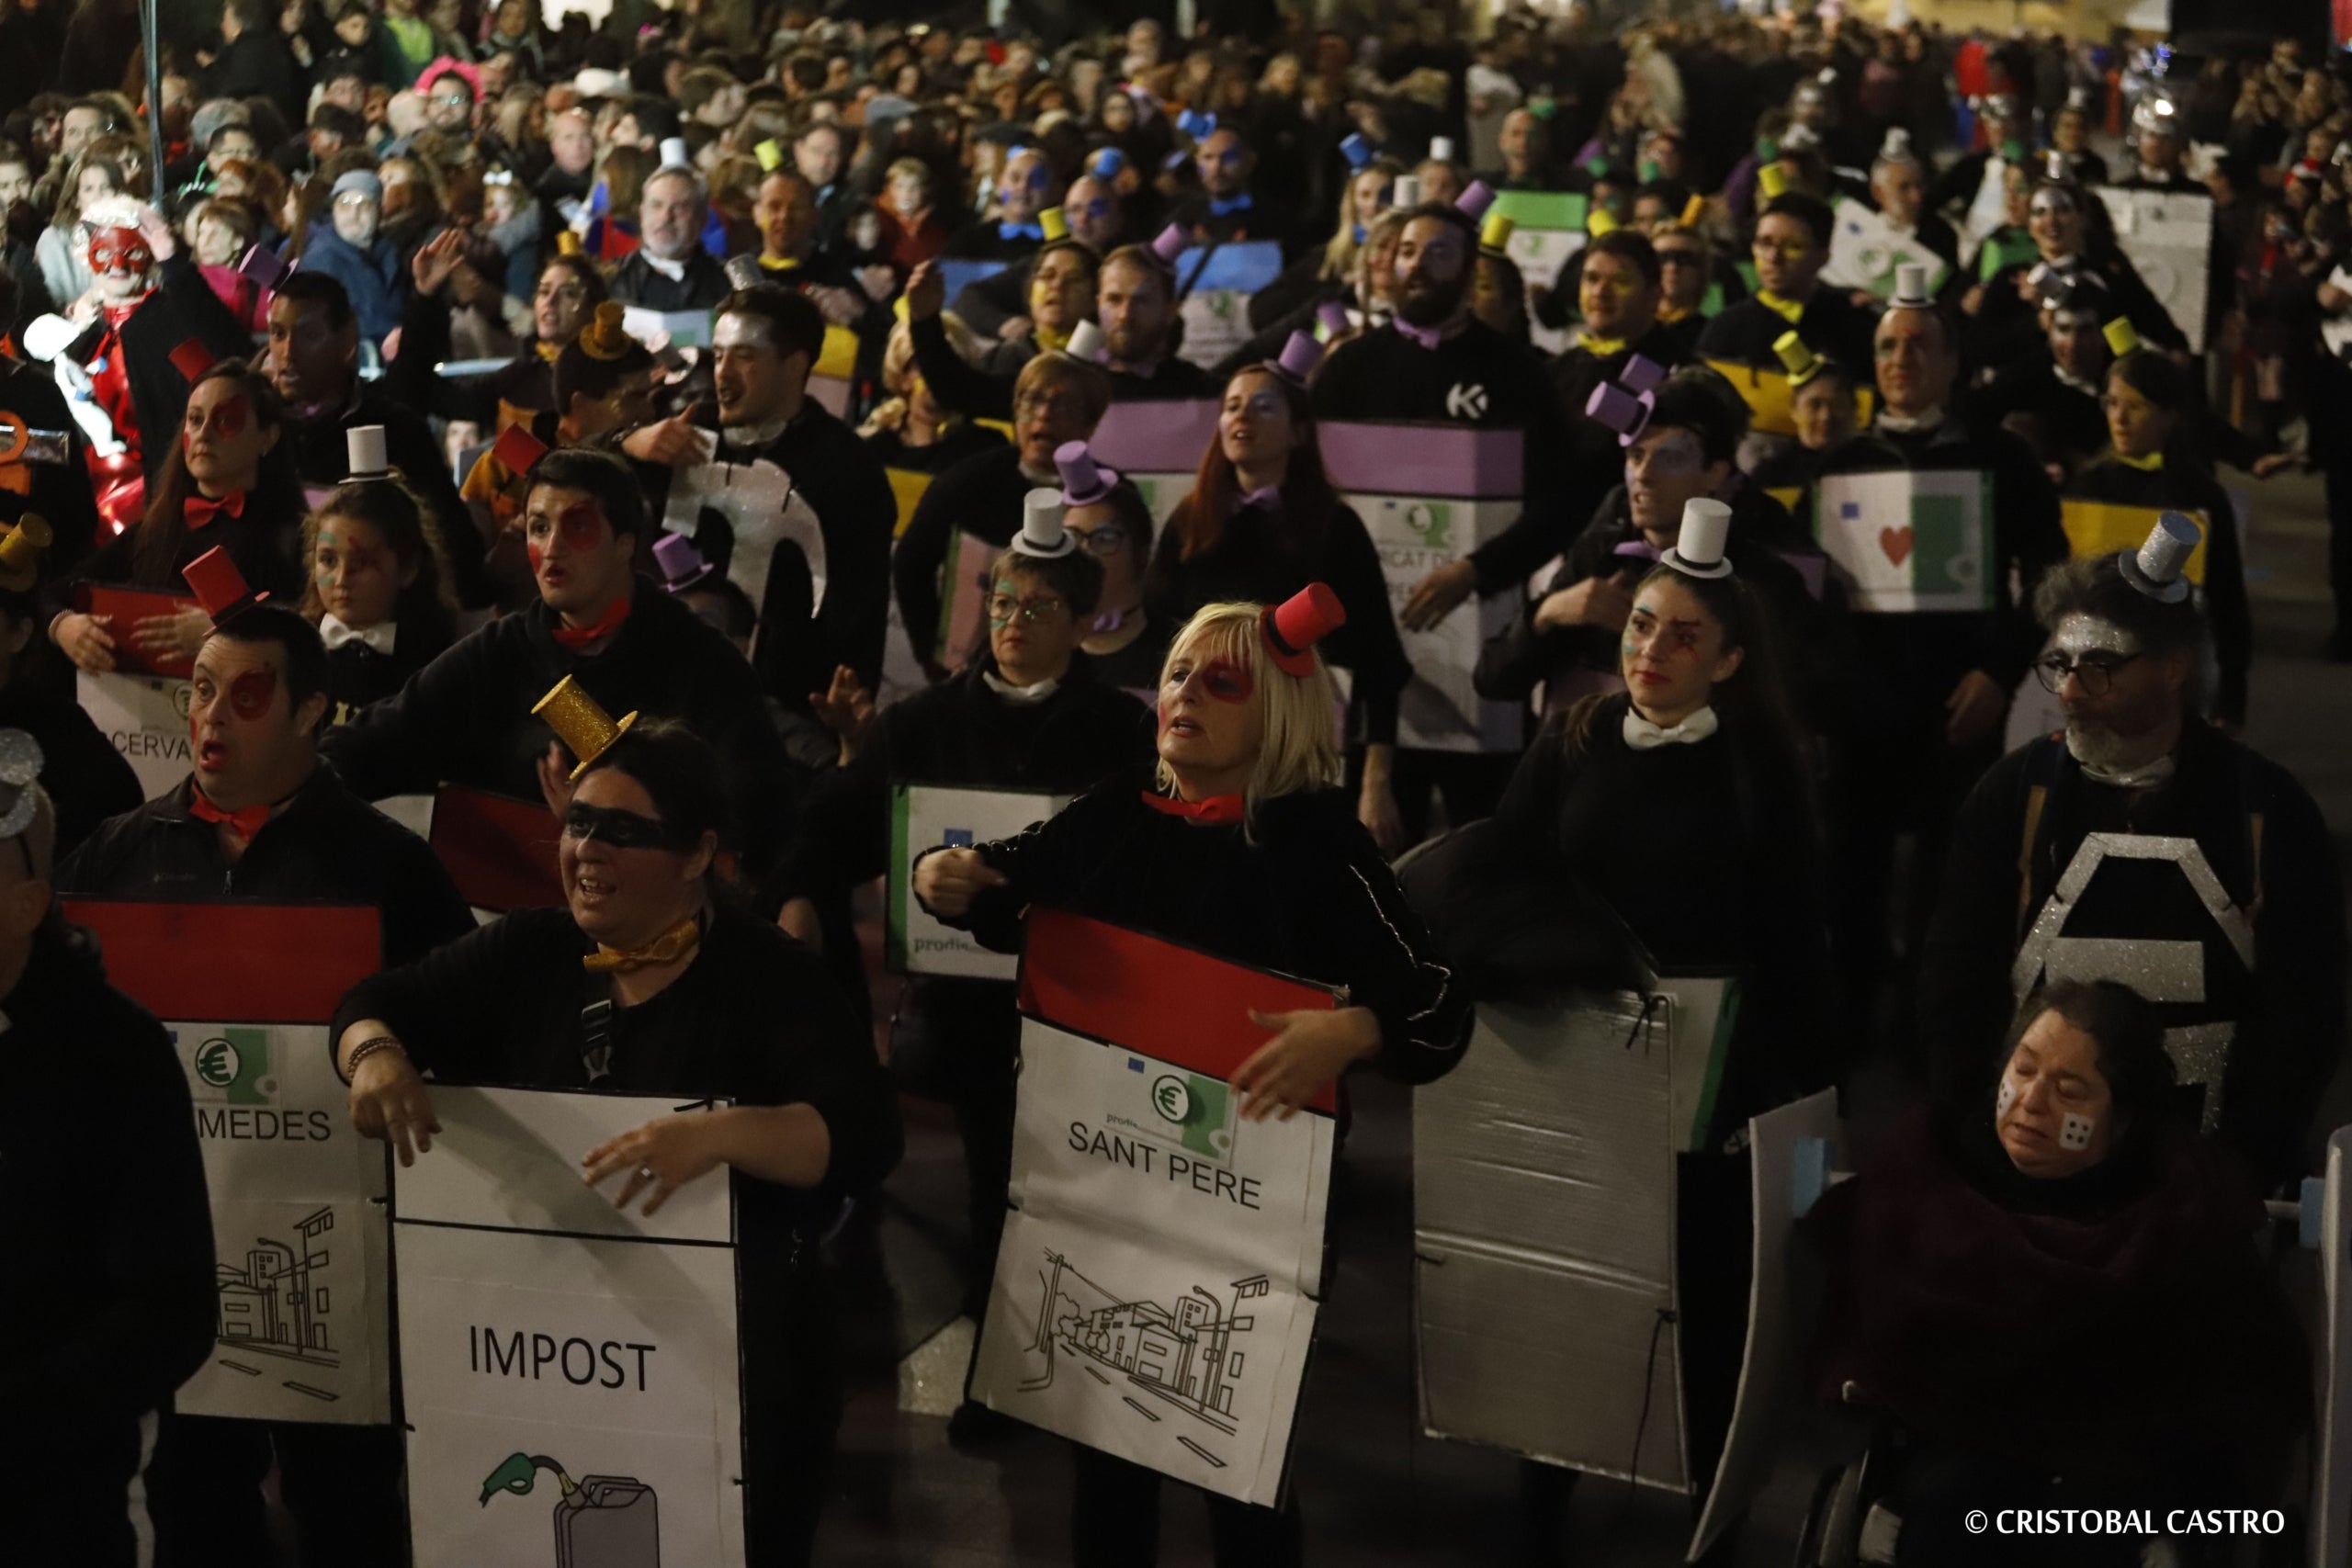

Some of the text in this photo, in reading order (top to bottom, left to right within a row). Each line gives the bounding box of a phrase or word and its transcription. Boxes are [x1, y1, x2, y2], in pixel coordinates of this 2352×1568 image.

[198, 1108, 331, 1141] MEDES
[1069, 1122, 1261, 1211] SANT PERE
[470, 1325, 656, 1392] IMPOST
